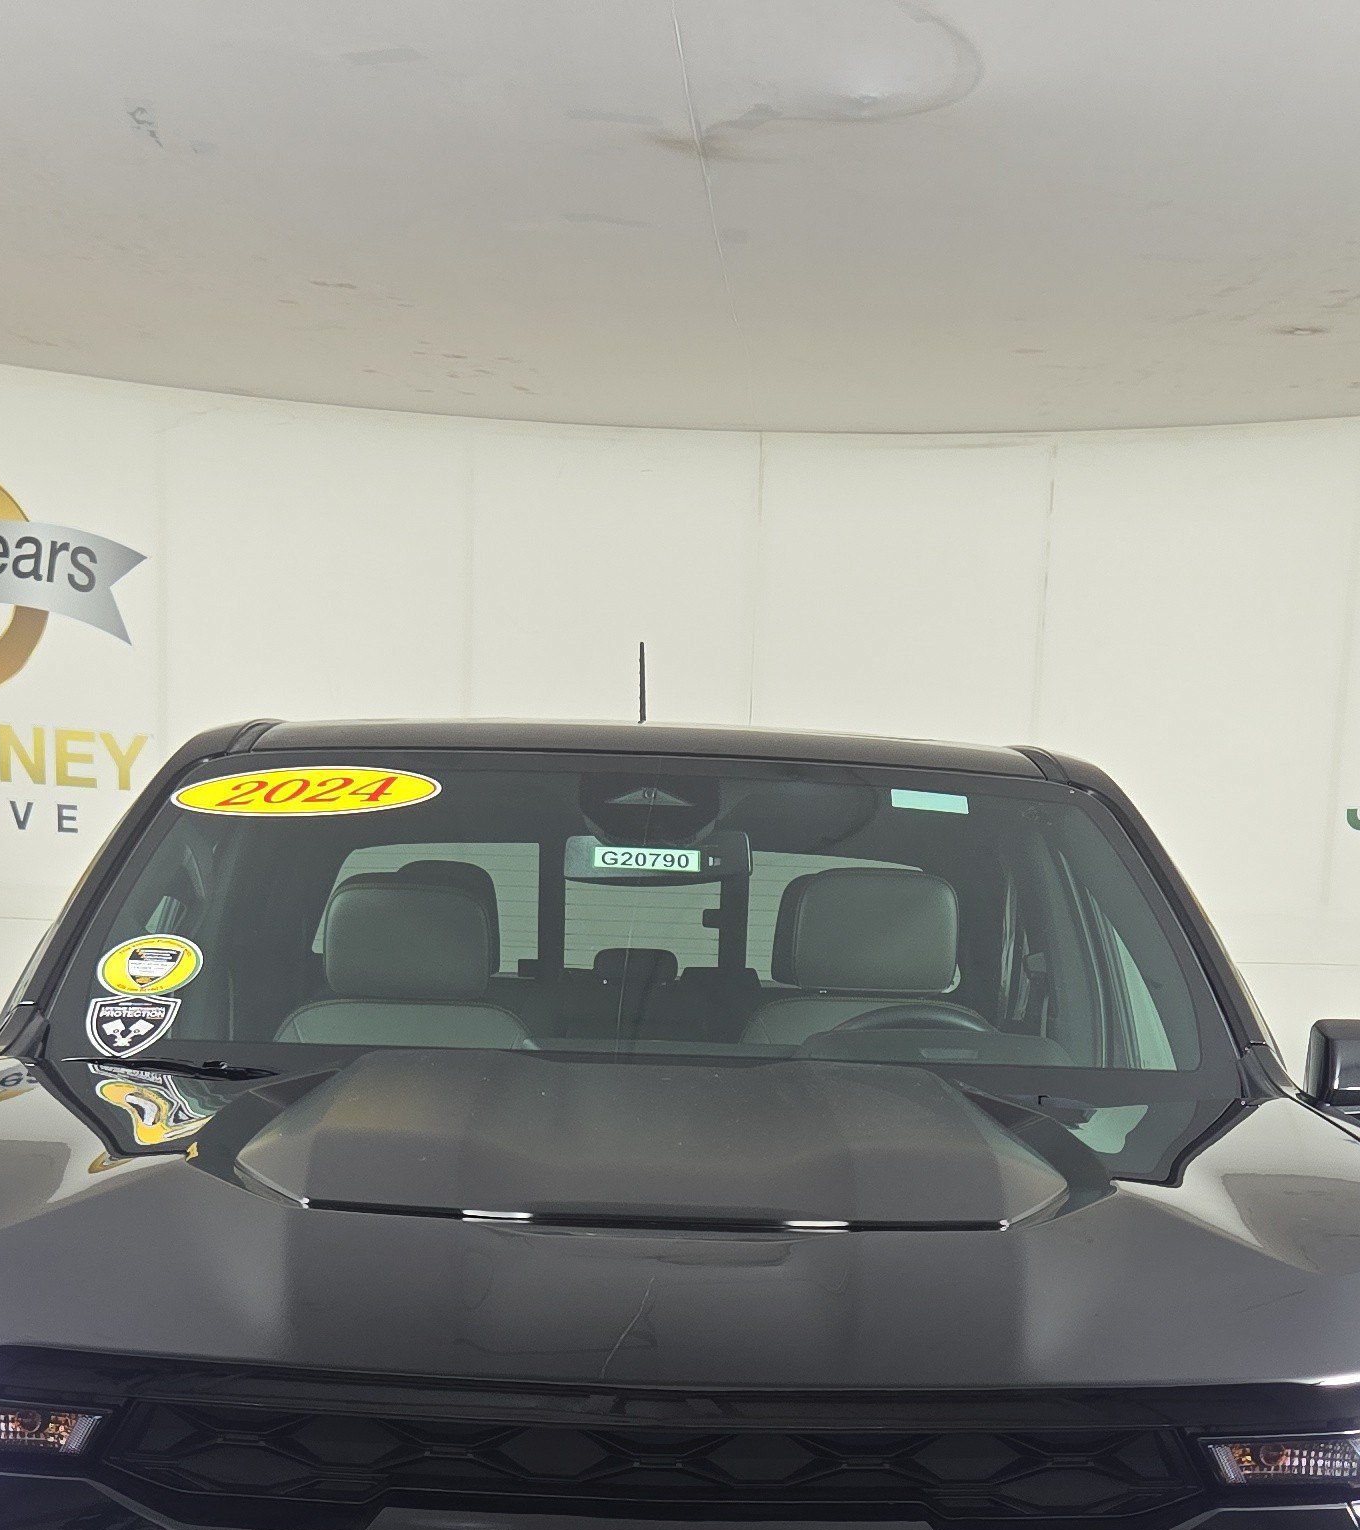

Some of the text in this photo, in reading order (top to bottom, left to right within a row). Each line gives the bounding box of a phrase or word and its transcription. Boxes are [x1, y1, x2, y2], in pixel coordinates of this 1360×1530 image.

[215, 777, 398, 807] 2024
[601, 851, 689, 868] G20790
[99, 1009, 166, 1018] PROTECTION
